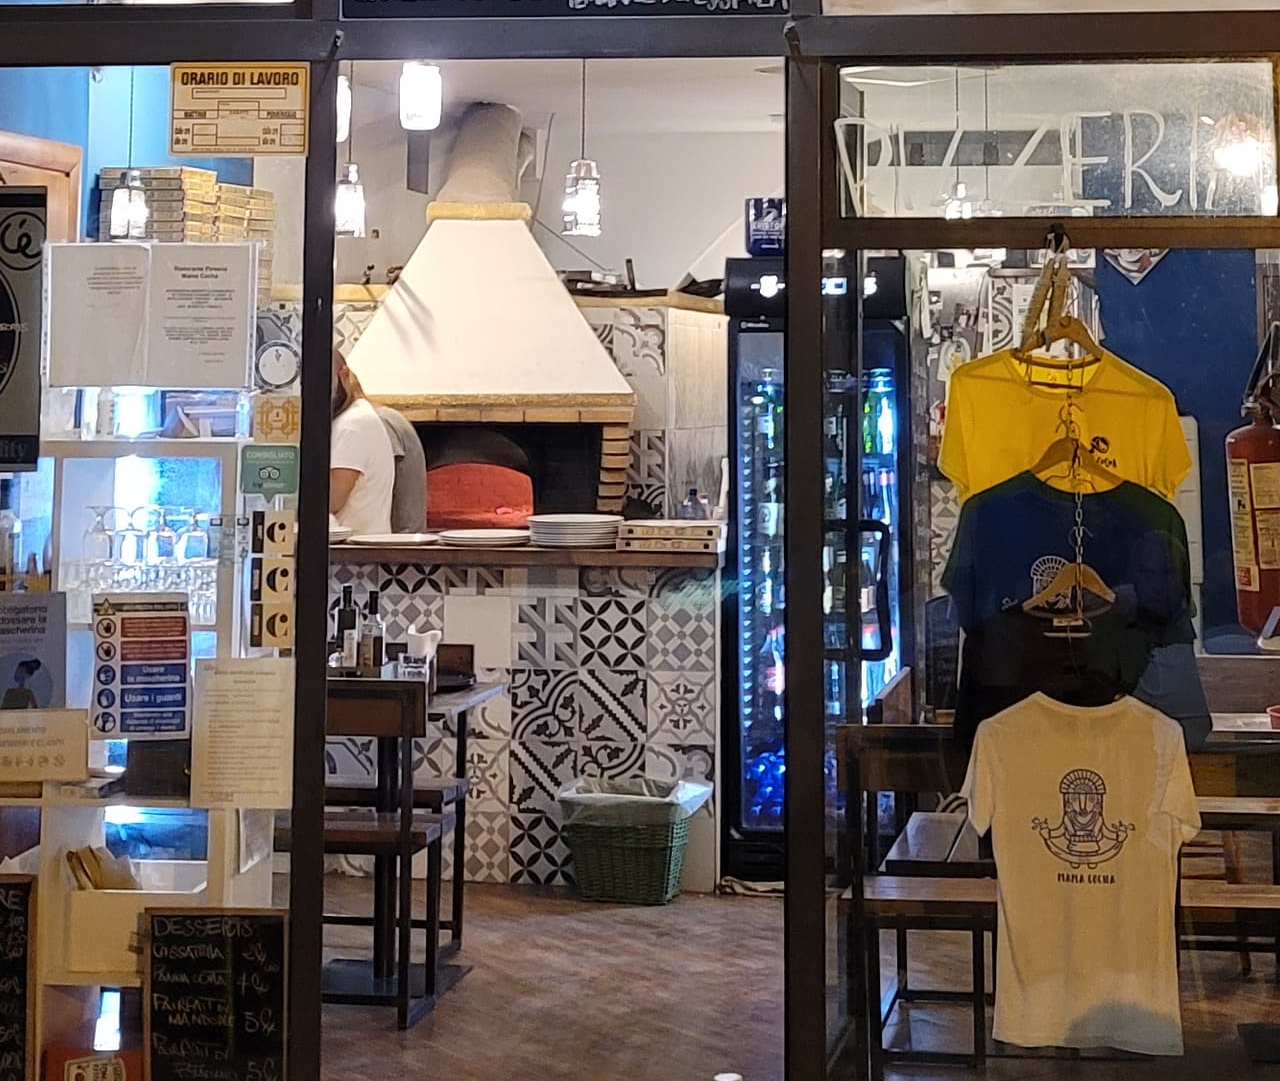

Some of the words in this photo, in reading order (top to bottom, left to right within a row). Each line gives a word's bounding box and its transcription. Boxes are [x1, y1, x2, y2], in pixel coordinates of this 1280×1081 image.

[181, 71, 228, 86] ORARIO
[233, 71, 245, 85] DI
[250, 71, 299, 85] LAVORO
[124, 693, 150, 703] Usare
[1057, 872, 1084, 884] MAMA
